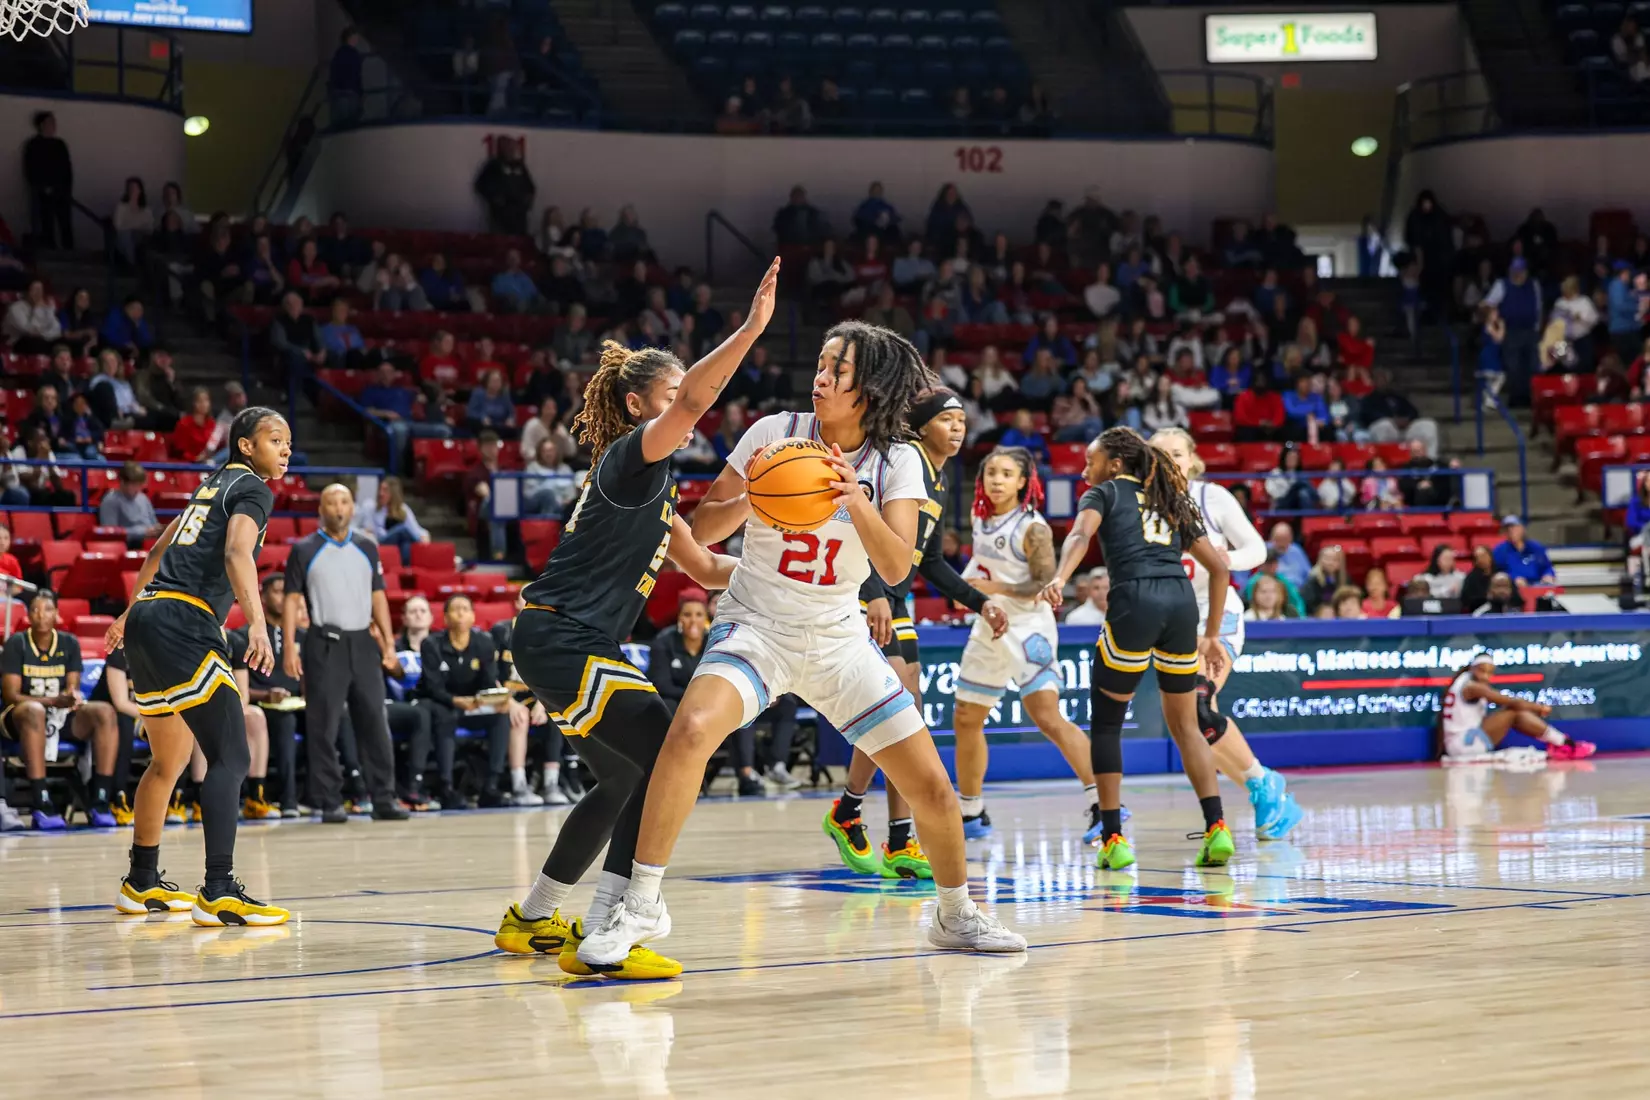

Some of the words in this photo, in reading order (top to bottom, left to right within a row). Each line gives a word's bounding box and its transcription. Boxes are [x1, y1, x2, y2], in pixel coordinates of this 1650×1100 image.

[1216, 25, 1278, 50] Super
[1281, 22, 1300, 55] 1
[1301, 24, 1365, 45] Foods
[953, 146, 1004, 173] 102
[169, 504, 212, 546] 15
[777, 533, 843, 586] 21
[1402, 645, 1439, 669] and
[1526, 641, 1642, 668] Headquarters
[29, 677, 60, 699] 33
[1232, 697, 1289, 719] Official
[1289, 695, 1356, 717] Furniture
[1357, 692, 1413, 714] Partner
